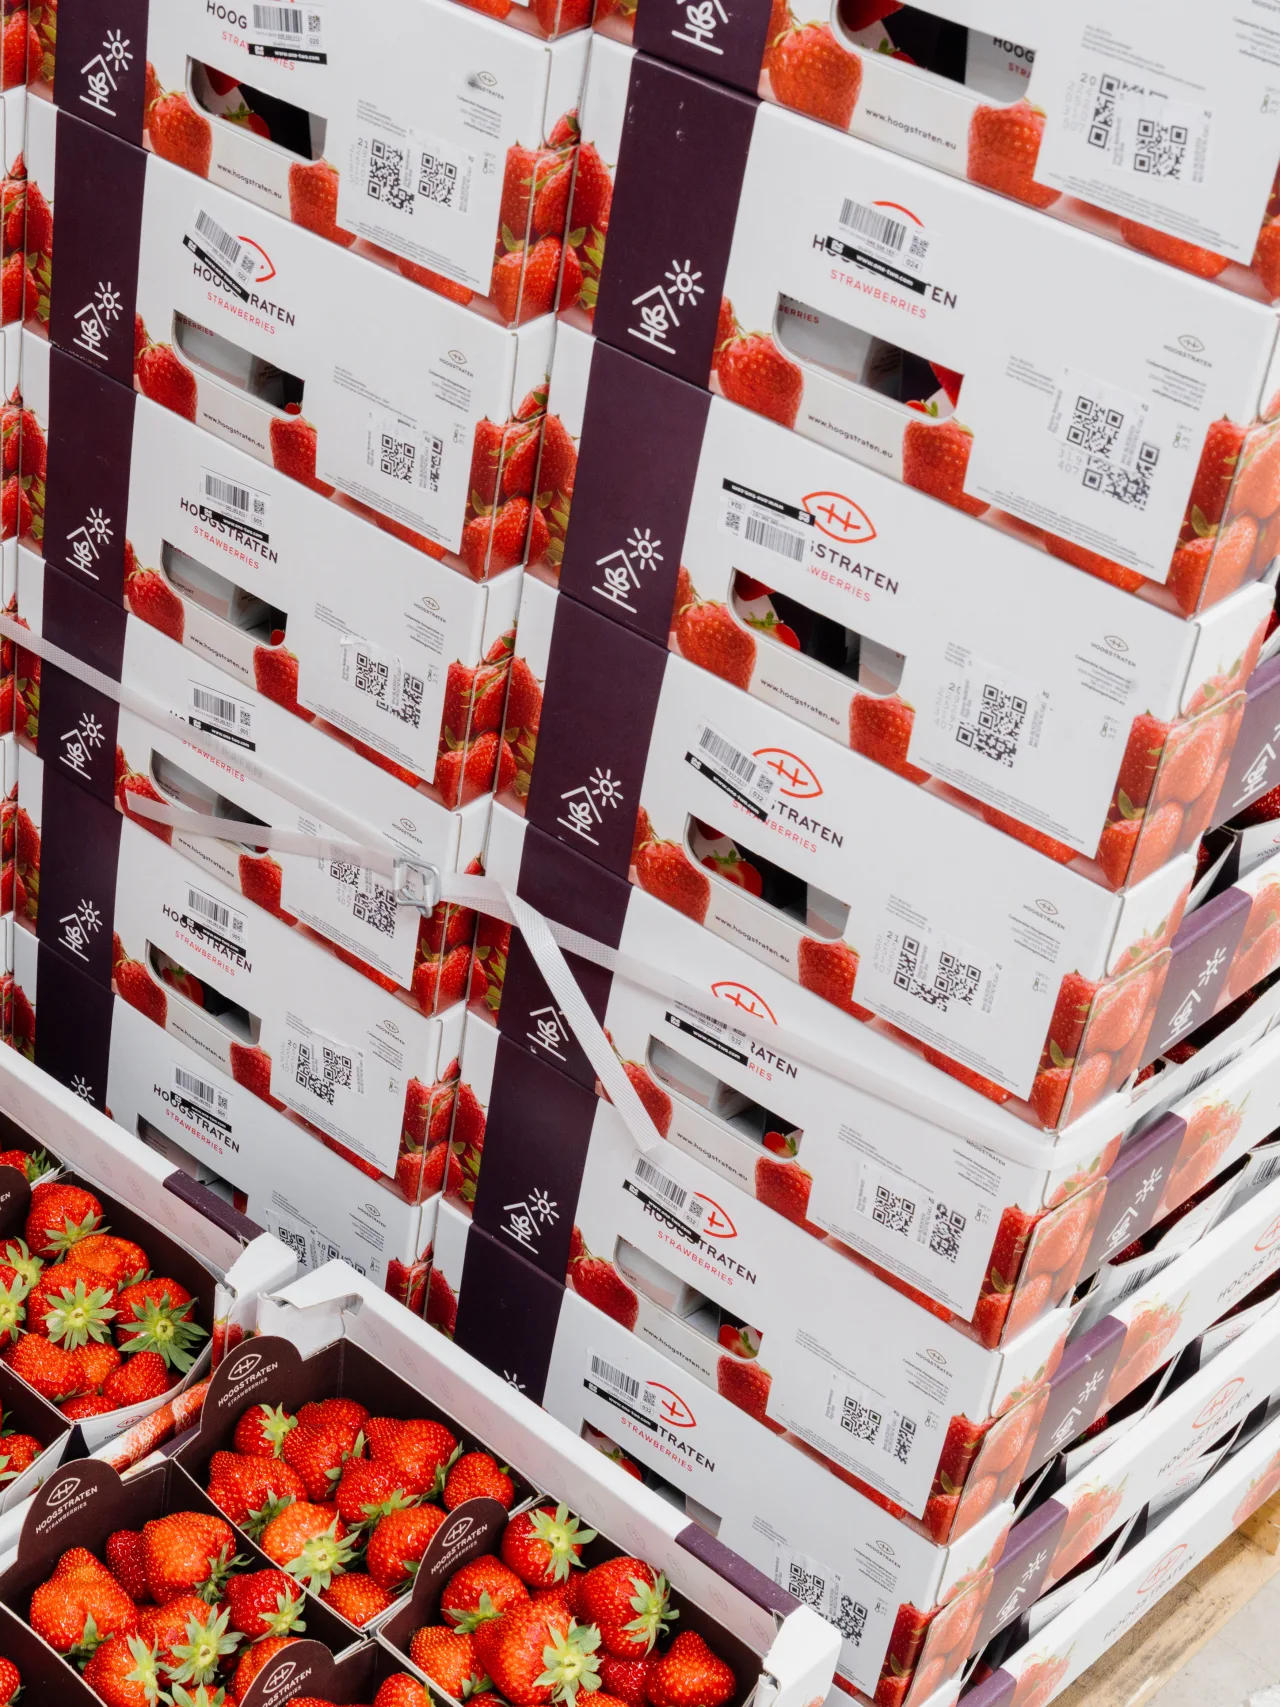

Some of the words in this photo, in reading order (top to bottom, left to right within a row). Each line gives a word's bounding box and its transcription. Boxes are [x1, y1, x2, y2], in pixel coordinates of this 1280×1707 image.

[864, 107, 958, 152] www.hoogstraten.eu
[216, 162, 283, 200] www.hoogstraten.eu
[206, 291, 276, 335] STRAWBERRIES
[830, 268, 928, 319] STRAWBERRIES
[203, 410, 266, 451] www.hoogstraten.eu
[807, 413, 894, 459] www.hoogstraten.eu
[193, 524, 260, 570] STRAWBERRIES
[189, 633, 250, 675] www.hoogstraten.eu
[760, 676, 841, 726] www.hoogstraten.eu
[175, 930, 236, 977] STRAWBERRIES
[715, 913, 791, 964] www.hoogstraten.eu
[153, 1083, 240, 1154] HOOGSTRATEN
[165, 1108, 224, 1156] STRAWBERRIES
[676, 1131, 748, 1182] www.hoogstraten.eu
[657, 1229, 734, 1287] STRAWBERRIES
[641, 1325, 711, 1377] www.hoogstraten.eu
[218, 1361, 279, 1407] HOOGSTRATEN
[620, 1416, 694, 1473] STRAWBERRIES
[659, 1425, 716, 1473] TRATEN
[35, 1485, 98, 1535] HOOGSTRATEN
[431, 1523, 488, 1574] HOOGSTRATEN
